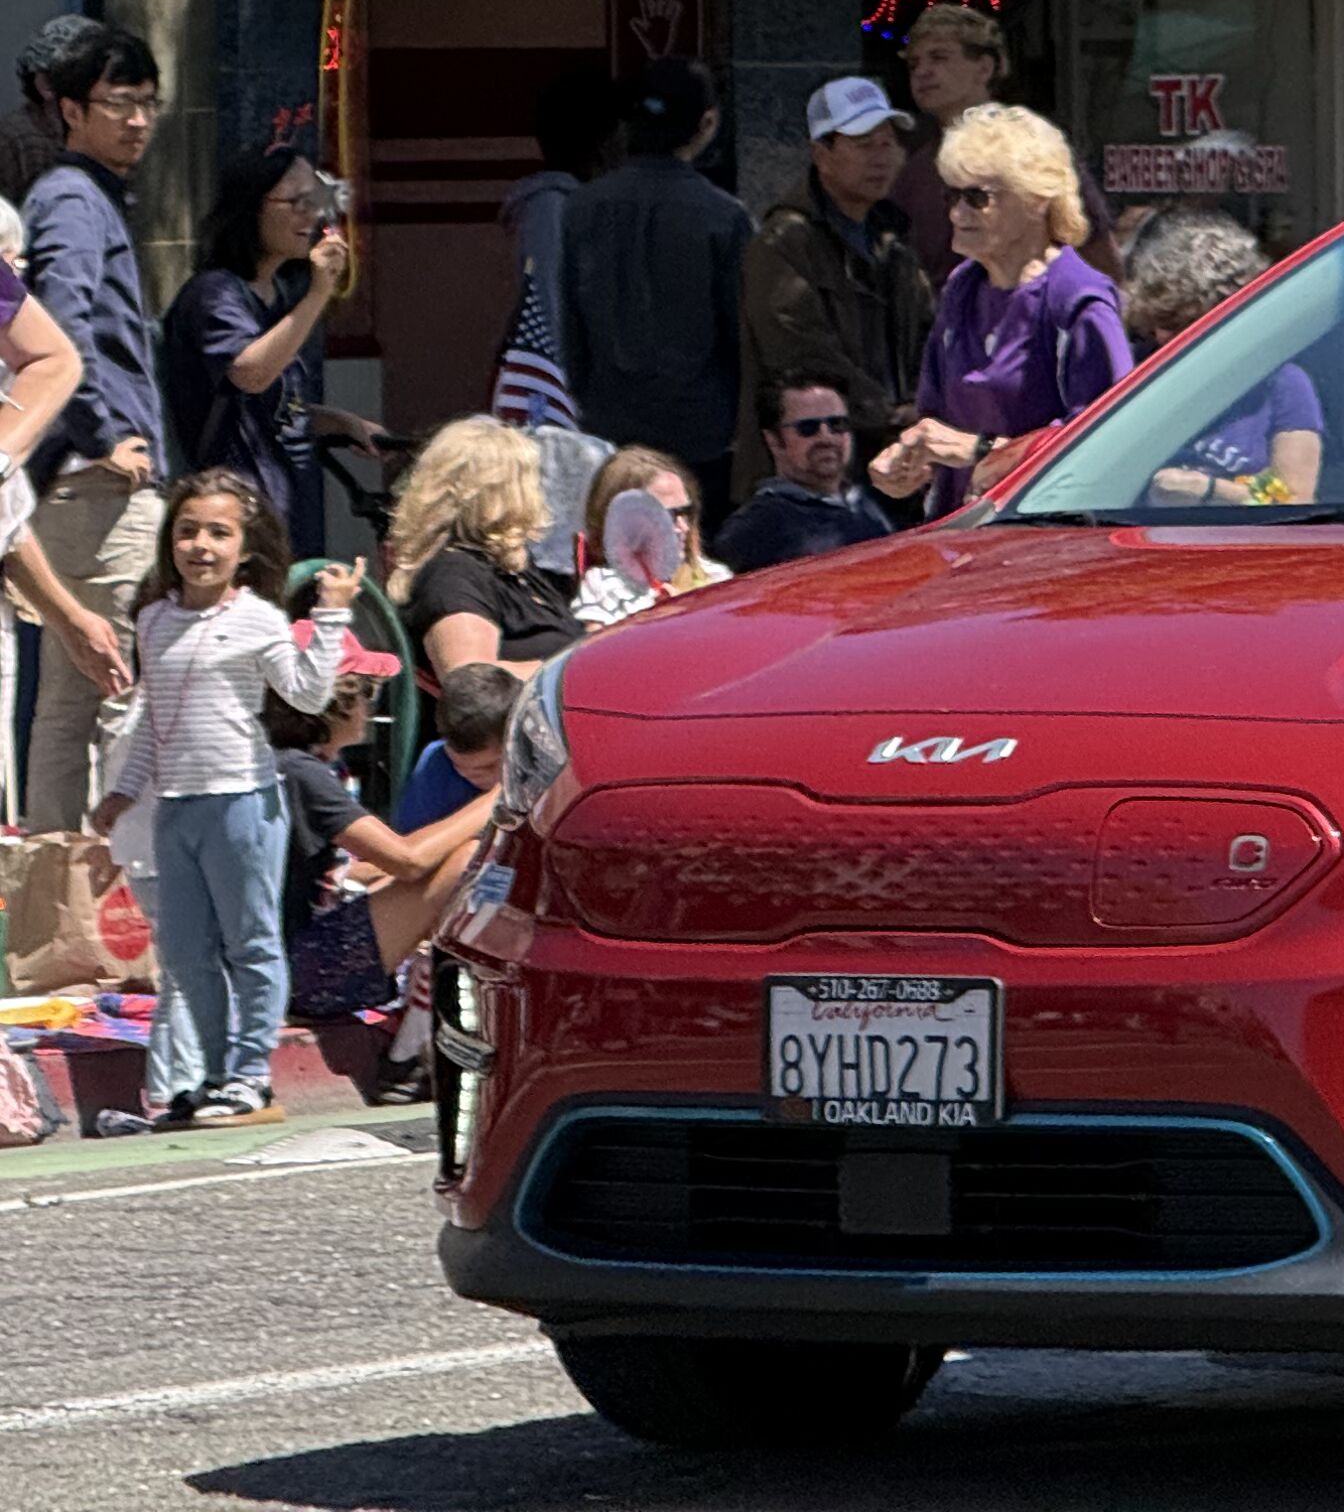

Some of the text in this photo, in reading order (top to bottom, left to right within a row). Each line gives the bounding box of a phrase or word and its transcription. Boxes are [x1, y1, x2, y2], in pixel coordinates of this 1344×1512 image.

[1148, 73, 1225, 137] TK
[866, 736, 1019, 764] KIA
[780, 1034, 980, 1099] 8YHD273
[823, 1100, 978, 1127] OAKLAND KIA
